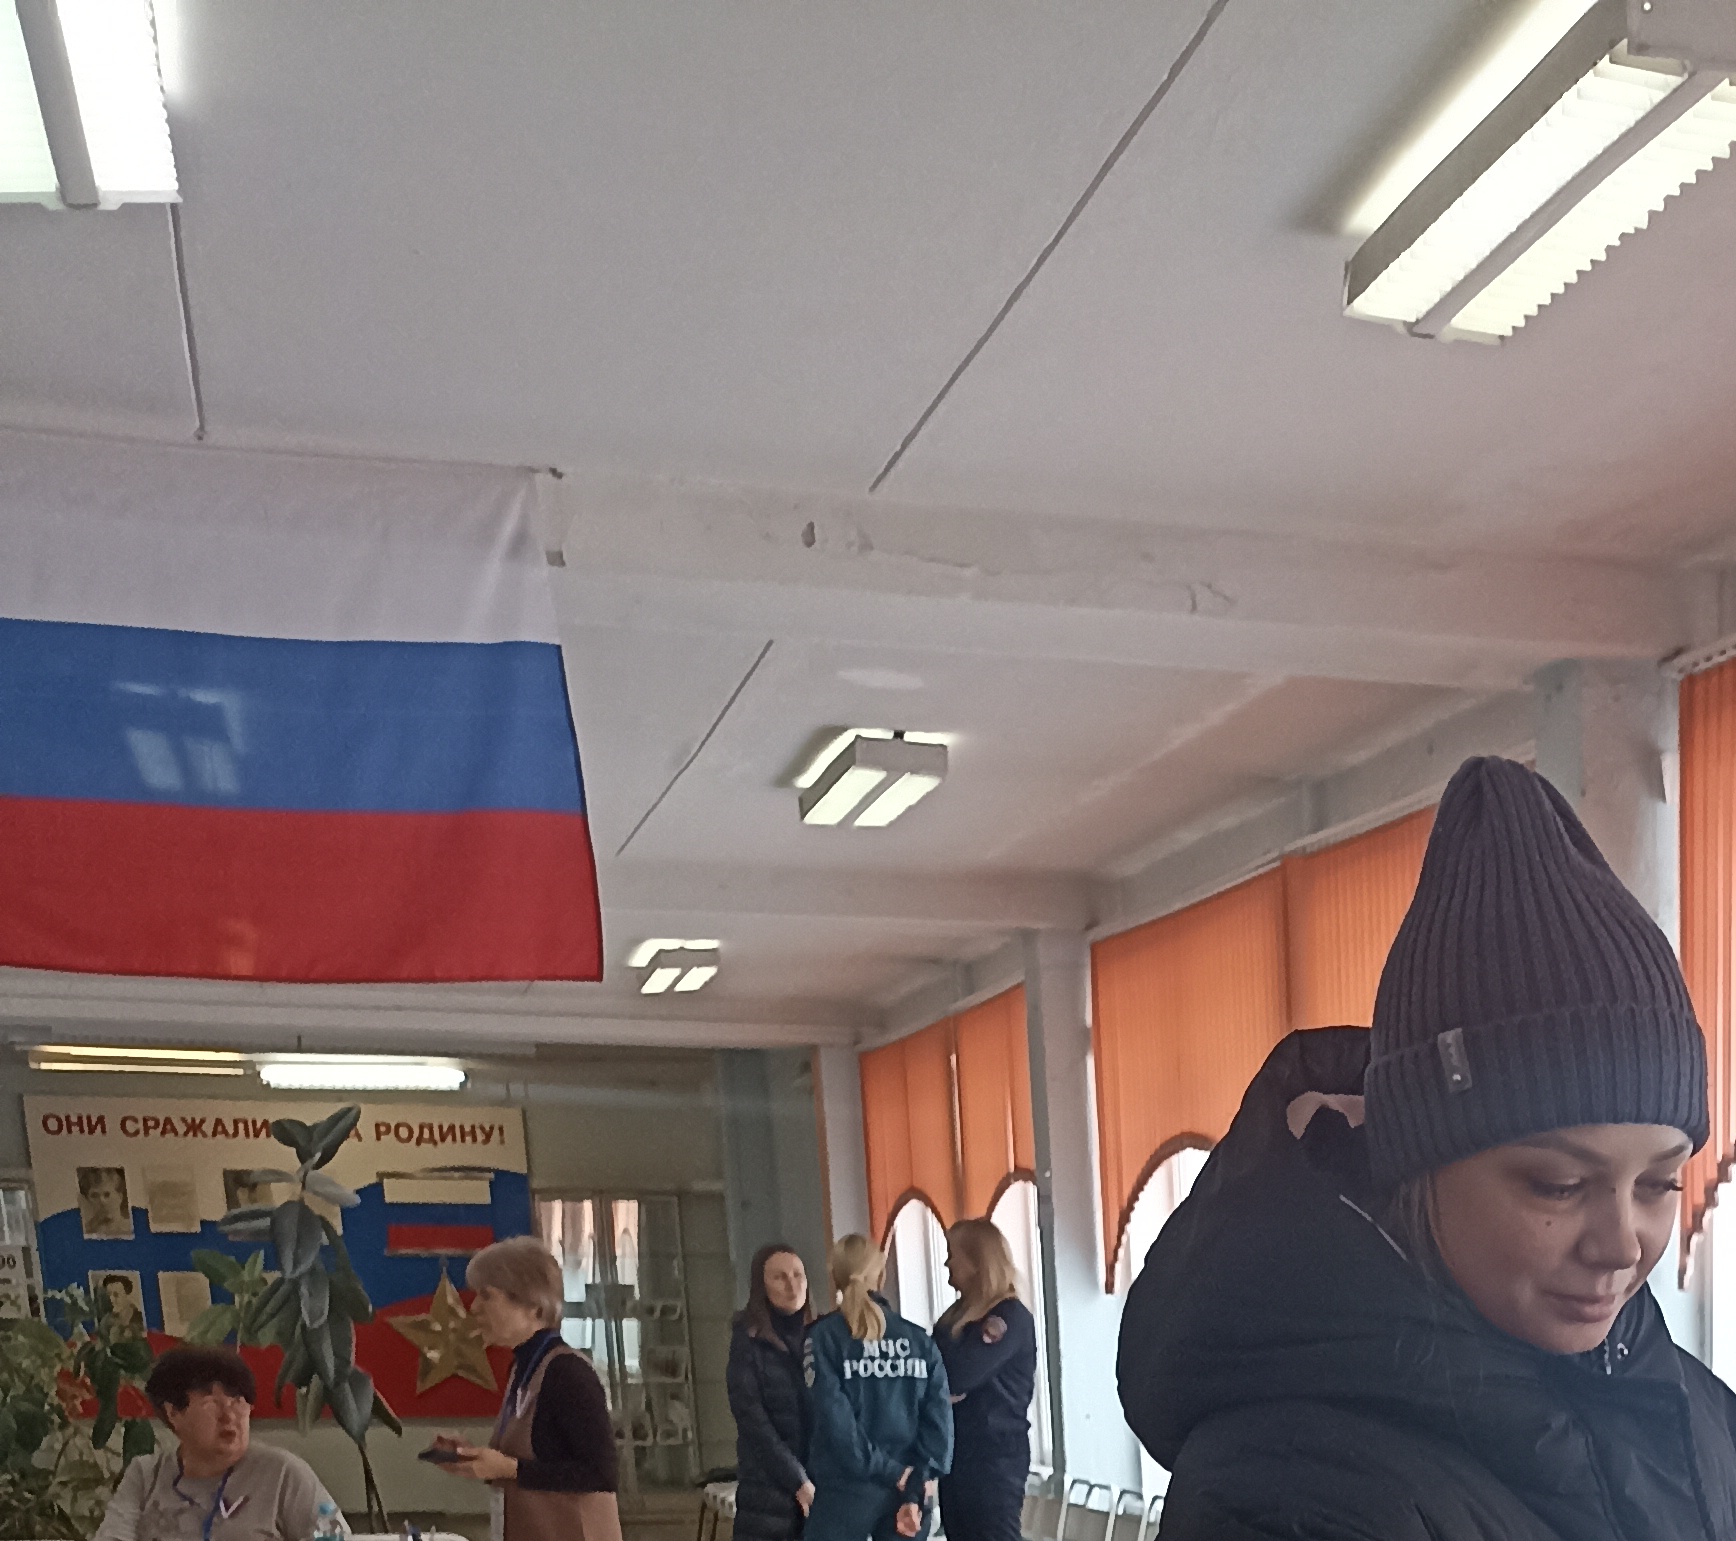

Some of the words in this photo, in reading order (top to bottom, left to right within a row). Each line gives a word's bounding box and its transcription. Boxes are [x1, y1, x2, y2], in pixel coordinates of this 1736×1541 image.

[41, 1113, 107, 1136] ОНИ
[119, 1115, 272, 1139] СРАЖАЛИ
[374, 1121, 506, 1147] РОДИНУ!
[862, 1337, 911, 1358] МЧС
[843, 1358, 928, 1379] РОССИИ
